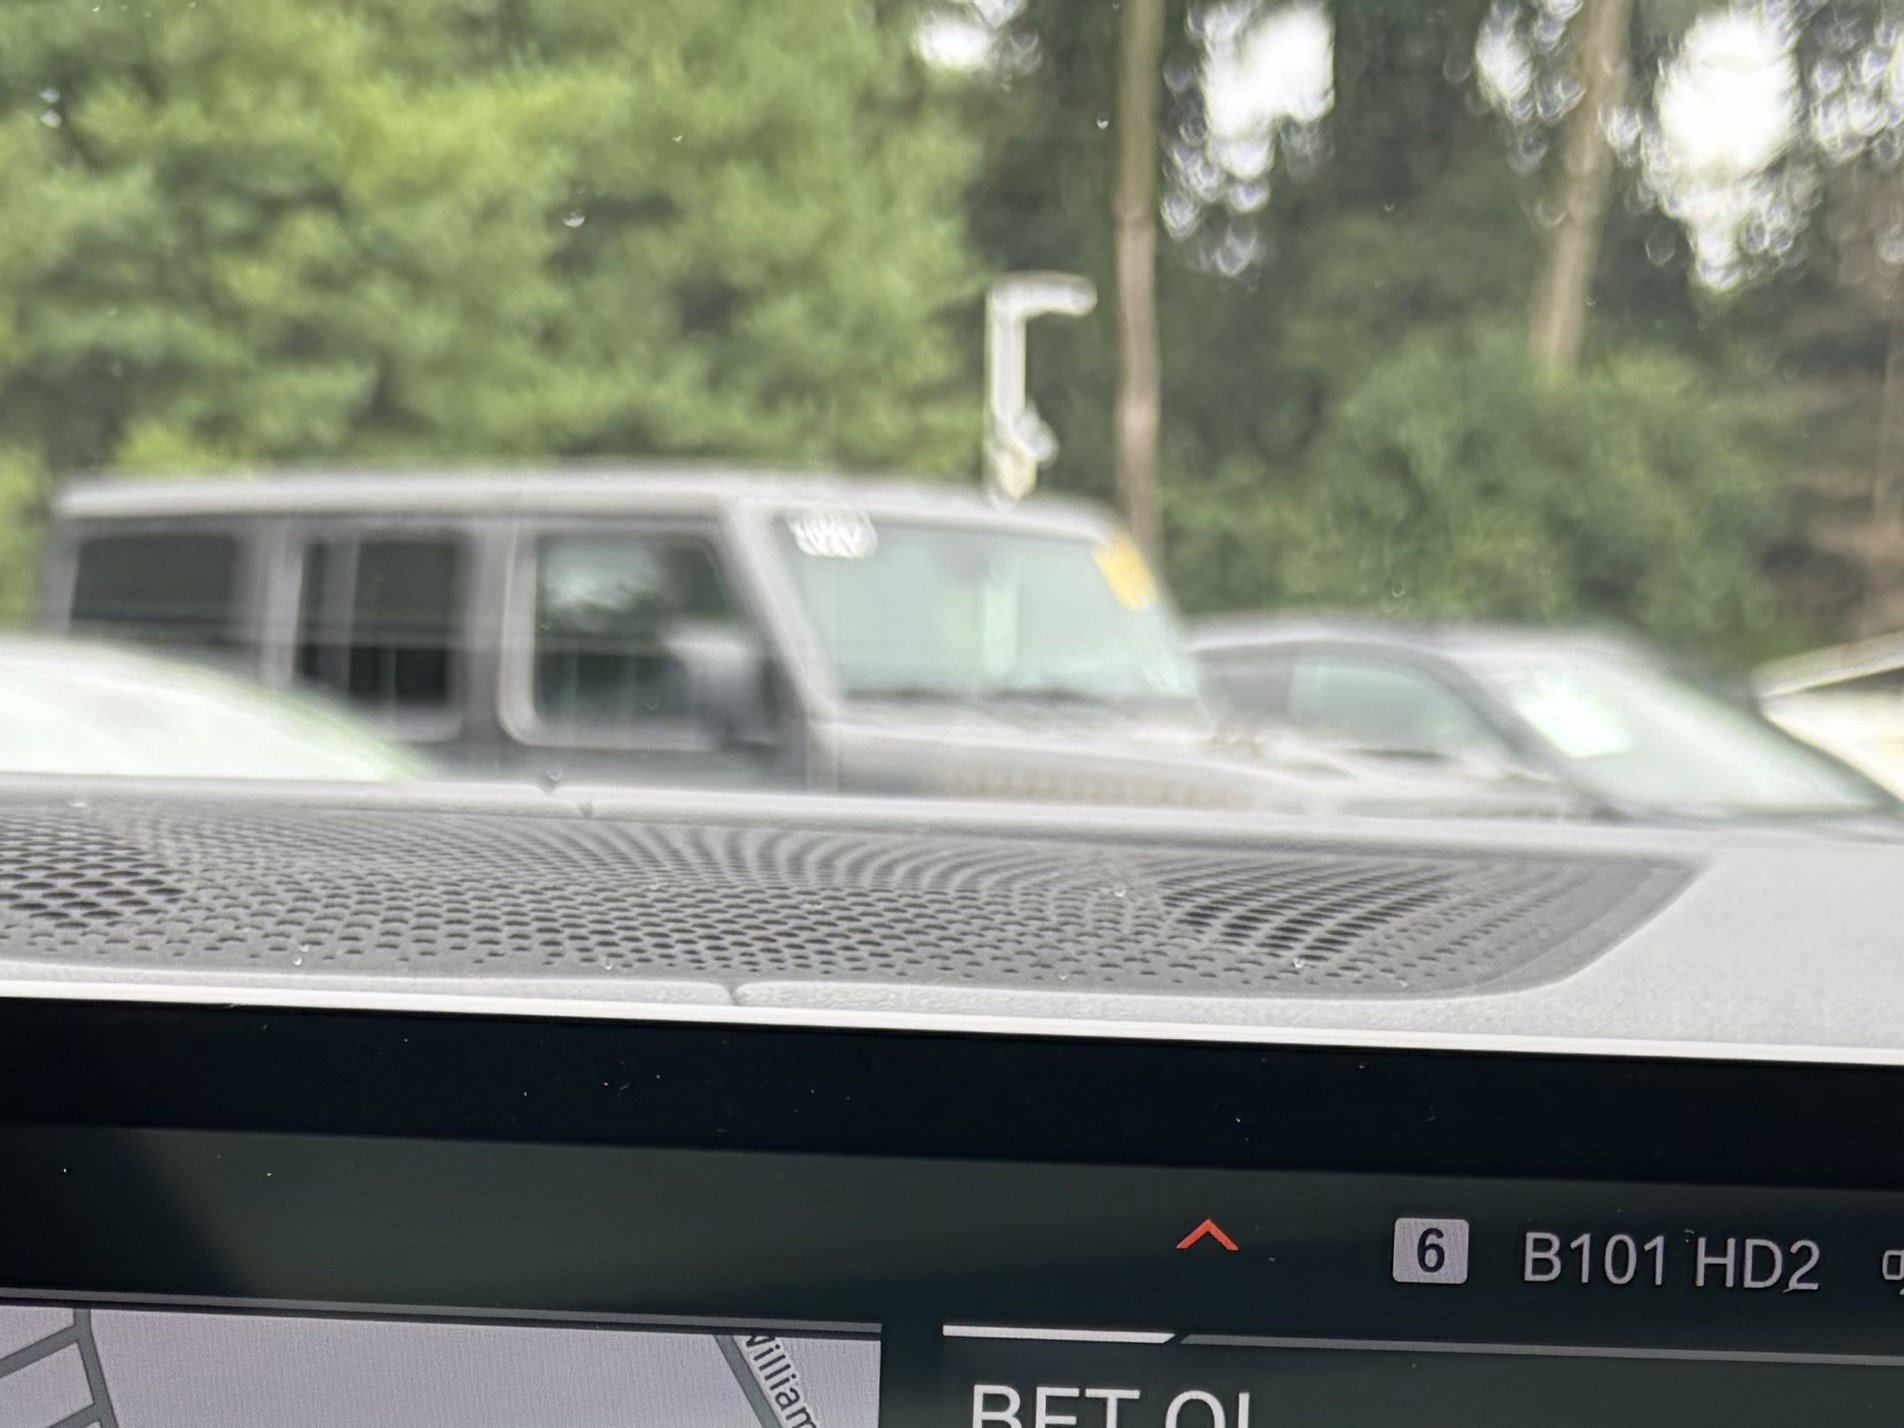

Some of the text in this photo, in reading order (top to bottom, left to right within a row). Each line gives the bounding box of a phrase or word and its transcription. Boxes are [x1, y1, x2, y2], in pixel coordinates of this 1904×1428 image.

[1416, 1227, 1447, 1273] 6
[1523, 1230, 1820, 1292] B101 HD2
